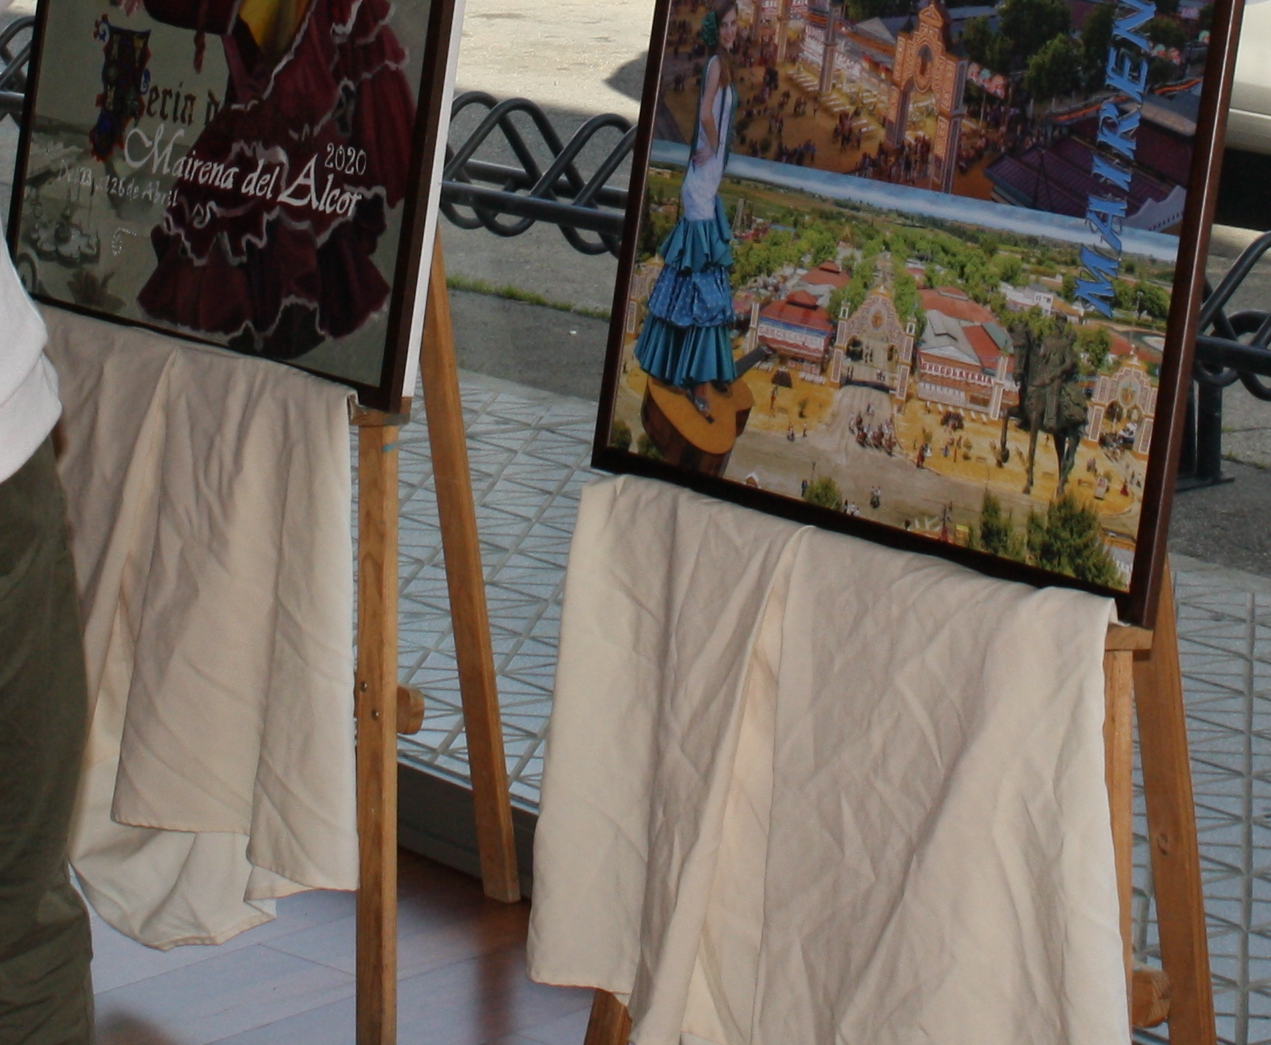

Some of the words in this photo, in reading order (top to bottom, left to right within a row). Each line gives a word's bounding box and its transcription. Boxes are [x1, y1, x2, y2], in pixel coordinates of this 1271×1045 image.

[124, 123, 237, 191] Mairena
[242, 162, 277, 201] del
[277, 153, 363, 218] Alcor
[324, 141, 367, 177] 2020
